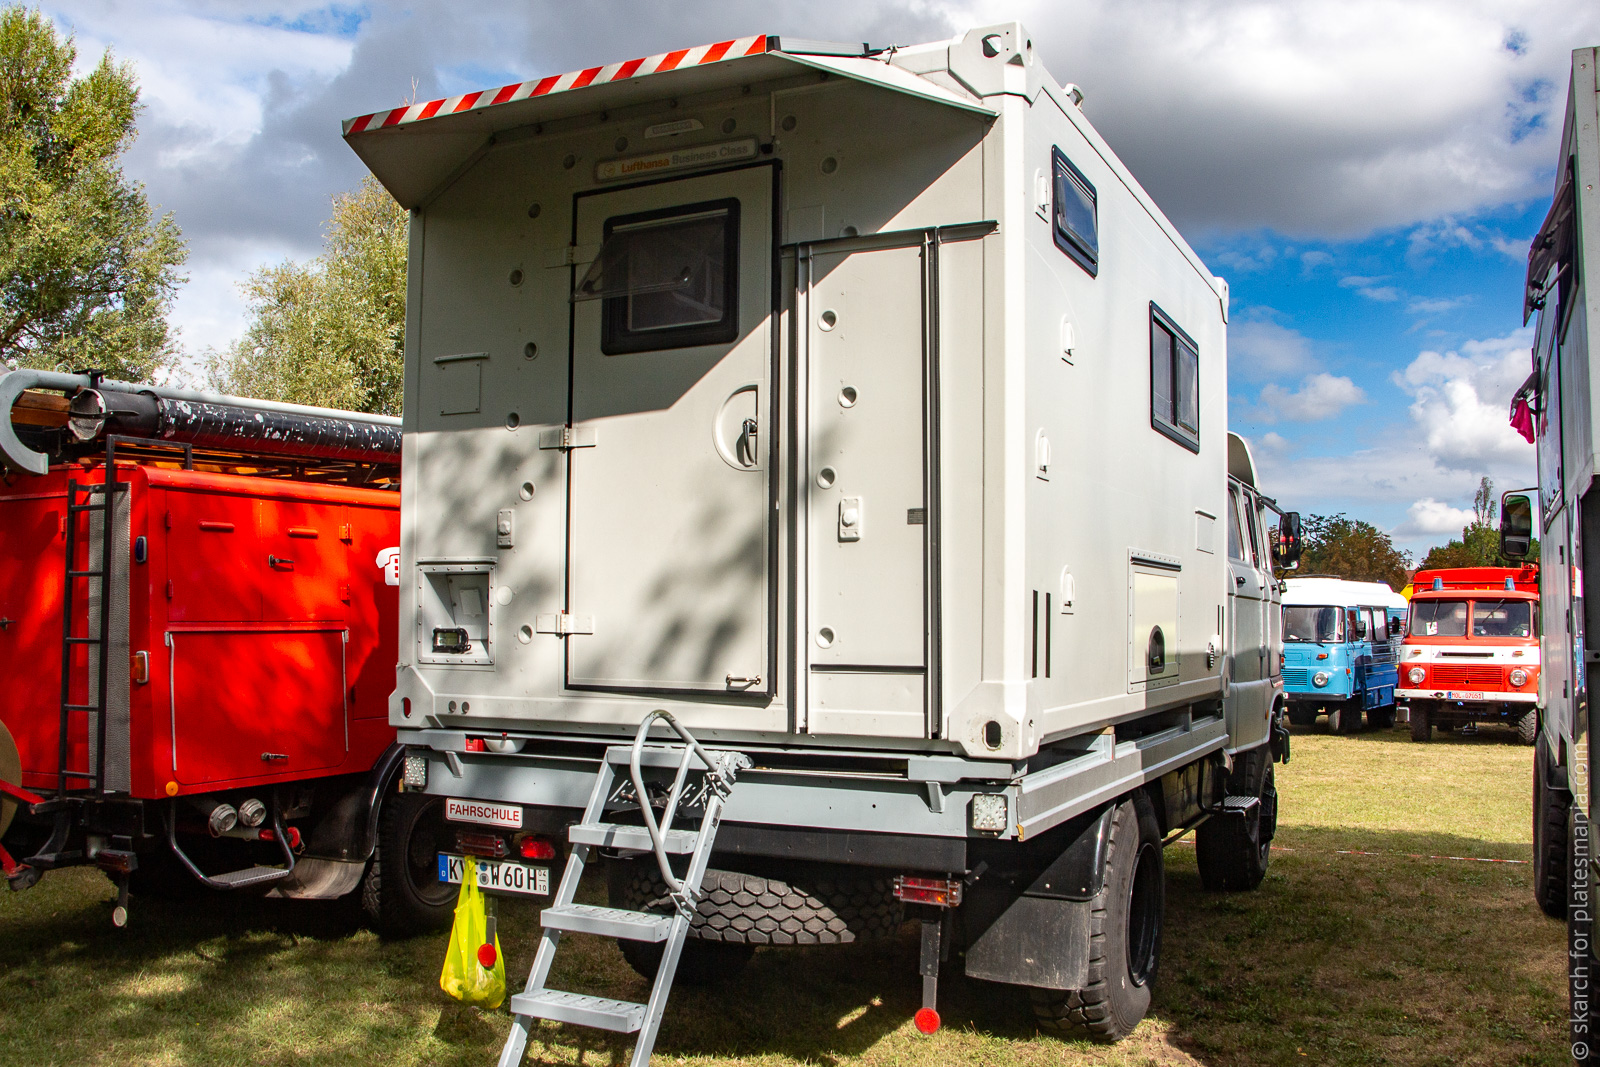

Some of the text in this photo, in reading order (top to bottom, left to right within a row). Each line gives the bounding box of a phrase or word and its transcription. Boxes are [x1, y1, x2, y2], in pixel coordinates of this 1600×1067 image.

[621, 145, 748, 174] Lufthansa Business Class
[449, 803, 520, 822] FAHRSCHULE
